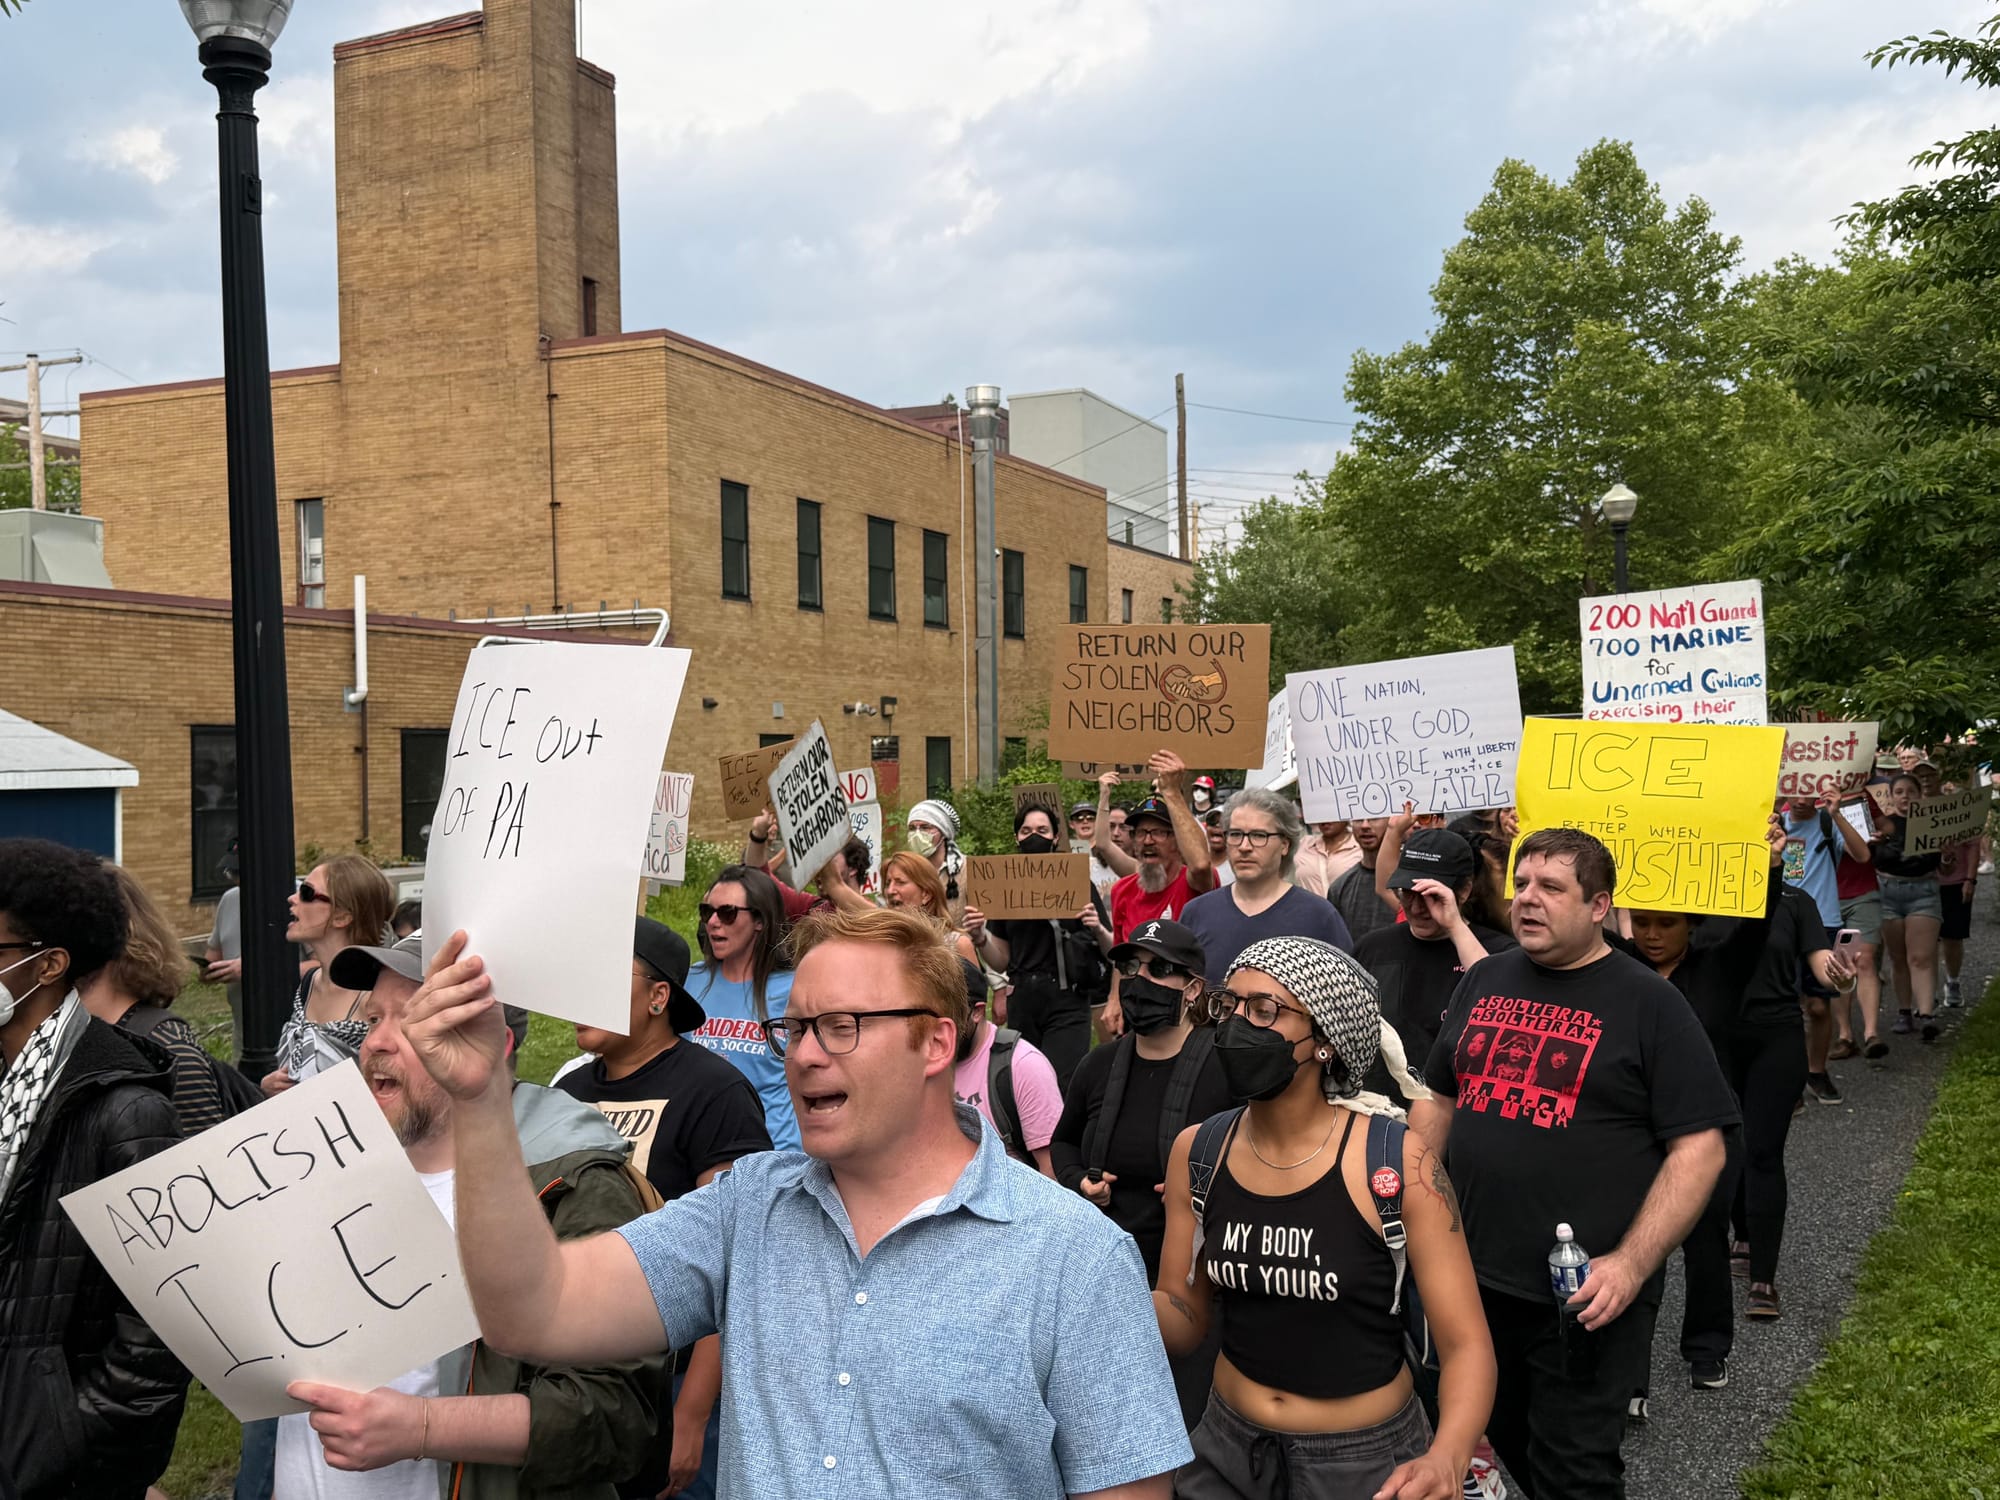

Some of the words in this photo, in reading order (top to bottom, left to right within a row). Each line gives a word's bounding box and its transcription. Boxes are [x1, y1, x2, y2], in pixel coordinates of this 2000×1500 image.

[1589, 604, 1642, 631] 200
[1701, 597, 1758, 623] Guard
[1078, 632, 1176, 658] RETURN
[1188, 631, 1245, 663] OUR
[1589, 638, 1641, 656] 700
[1062, 662, 1160, 691] STOLEN
[1644, 658, 1676, 676] for
[1300, 677, 1355, 722] ONE
[1592, 672, 1693, 703] Unarmed
[1701, 668, 1763, 693] Civilians
[453, 682, 531, 759] ICE
[1068, 700, 1235, 737] NEIGHBORS
[1589, 703, 1683, 723] exercising
[1694, 699, 1736, 716] their
[1325, 716, 1399, 753] UNDER
[1442, 746, 1471, 760] WITH
[1477, 741, 1516, 755] LIBERTY
[777, 754, 809, 811] RETURN
[808, 736, 830, 775] OUR
[1445, 761, 1503, 776] JUSTICE
[1548, 732, 1709, 799] ICE
[788, 766, 830, 827] STOLEN
[1334, 780, 1420, 820] FOR
[1429, 773, 1511, 813] ALL
[1780, 770, 1869, 796] ascism
[483, 781, 529, 860] PA
[1606, 804, 1629, 819] IS
[1909, 800, 1958, 818] RETURN
[1930, 811, 1971, 829] STOLEN
[788, 785, 847, 868] NEIGHBORS
[1562, 820, 1627, 834] BETTER
[1650, 824, 1702, 841] WHEN
[972, 860, 995, 881] NO
[1005, 857, 1069, 881] HUMAN
[974, 889, 992, 907] IS
[1003, 889, 1085, 913] ILLEGAL
[1482, 1010, 1579, 1038] SOLTERA
[1488, 996, 1590, 1026] SOLTERA
[721, 1039, 767, 1056] SOCCER
[604, 1109, 655, 1138] TED
[107, 1101, 365, 1265] ABOLISH
[1374, 1173, 1396, 1184] STOP
[1222, 1222, 1253, 1253] MY
[1261, 1225, 1321, 1266] BODY,
[1207, 1259, 1249, 1292] NOT
[1259, 1265, 1339, 1301] YOURS
